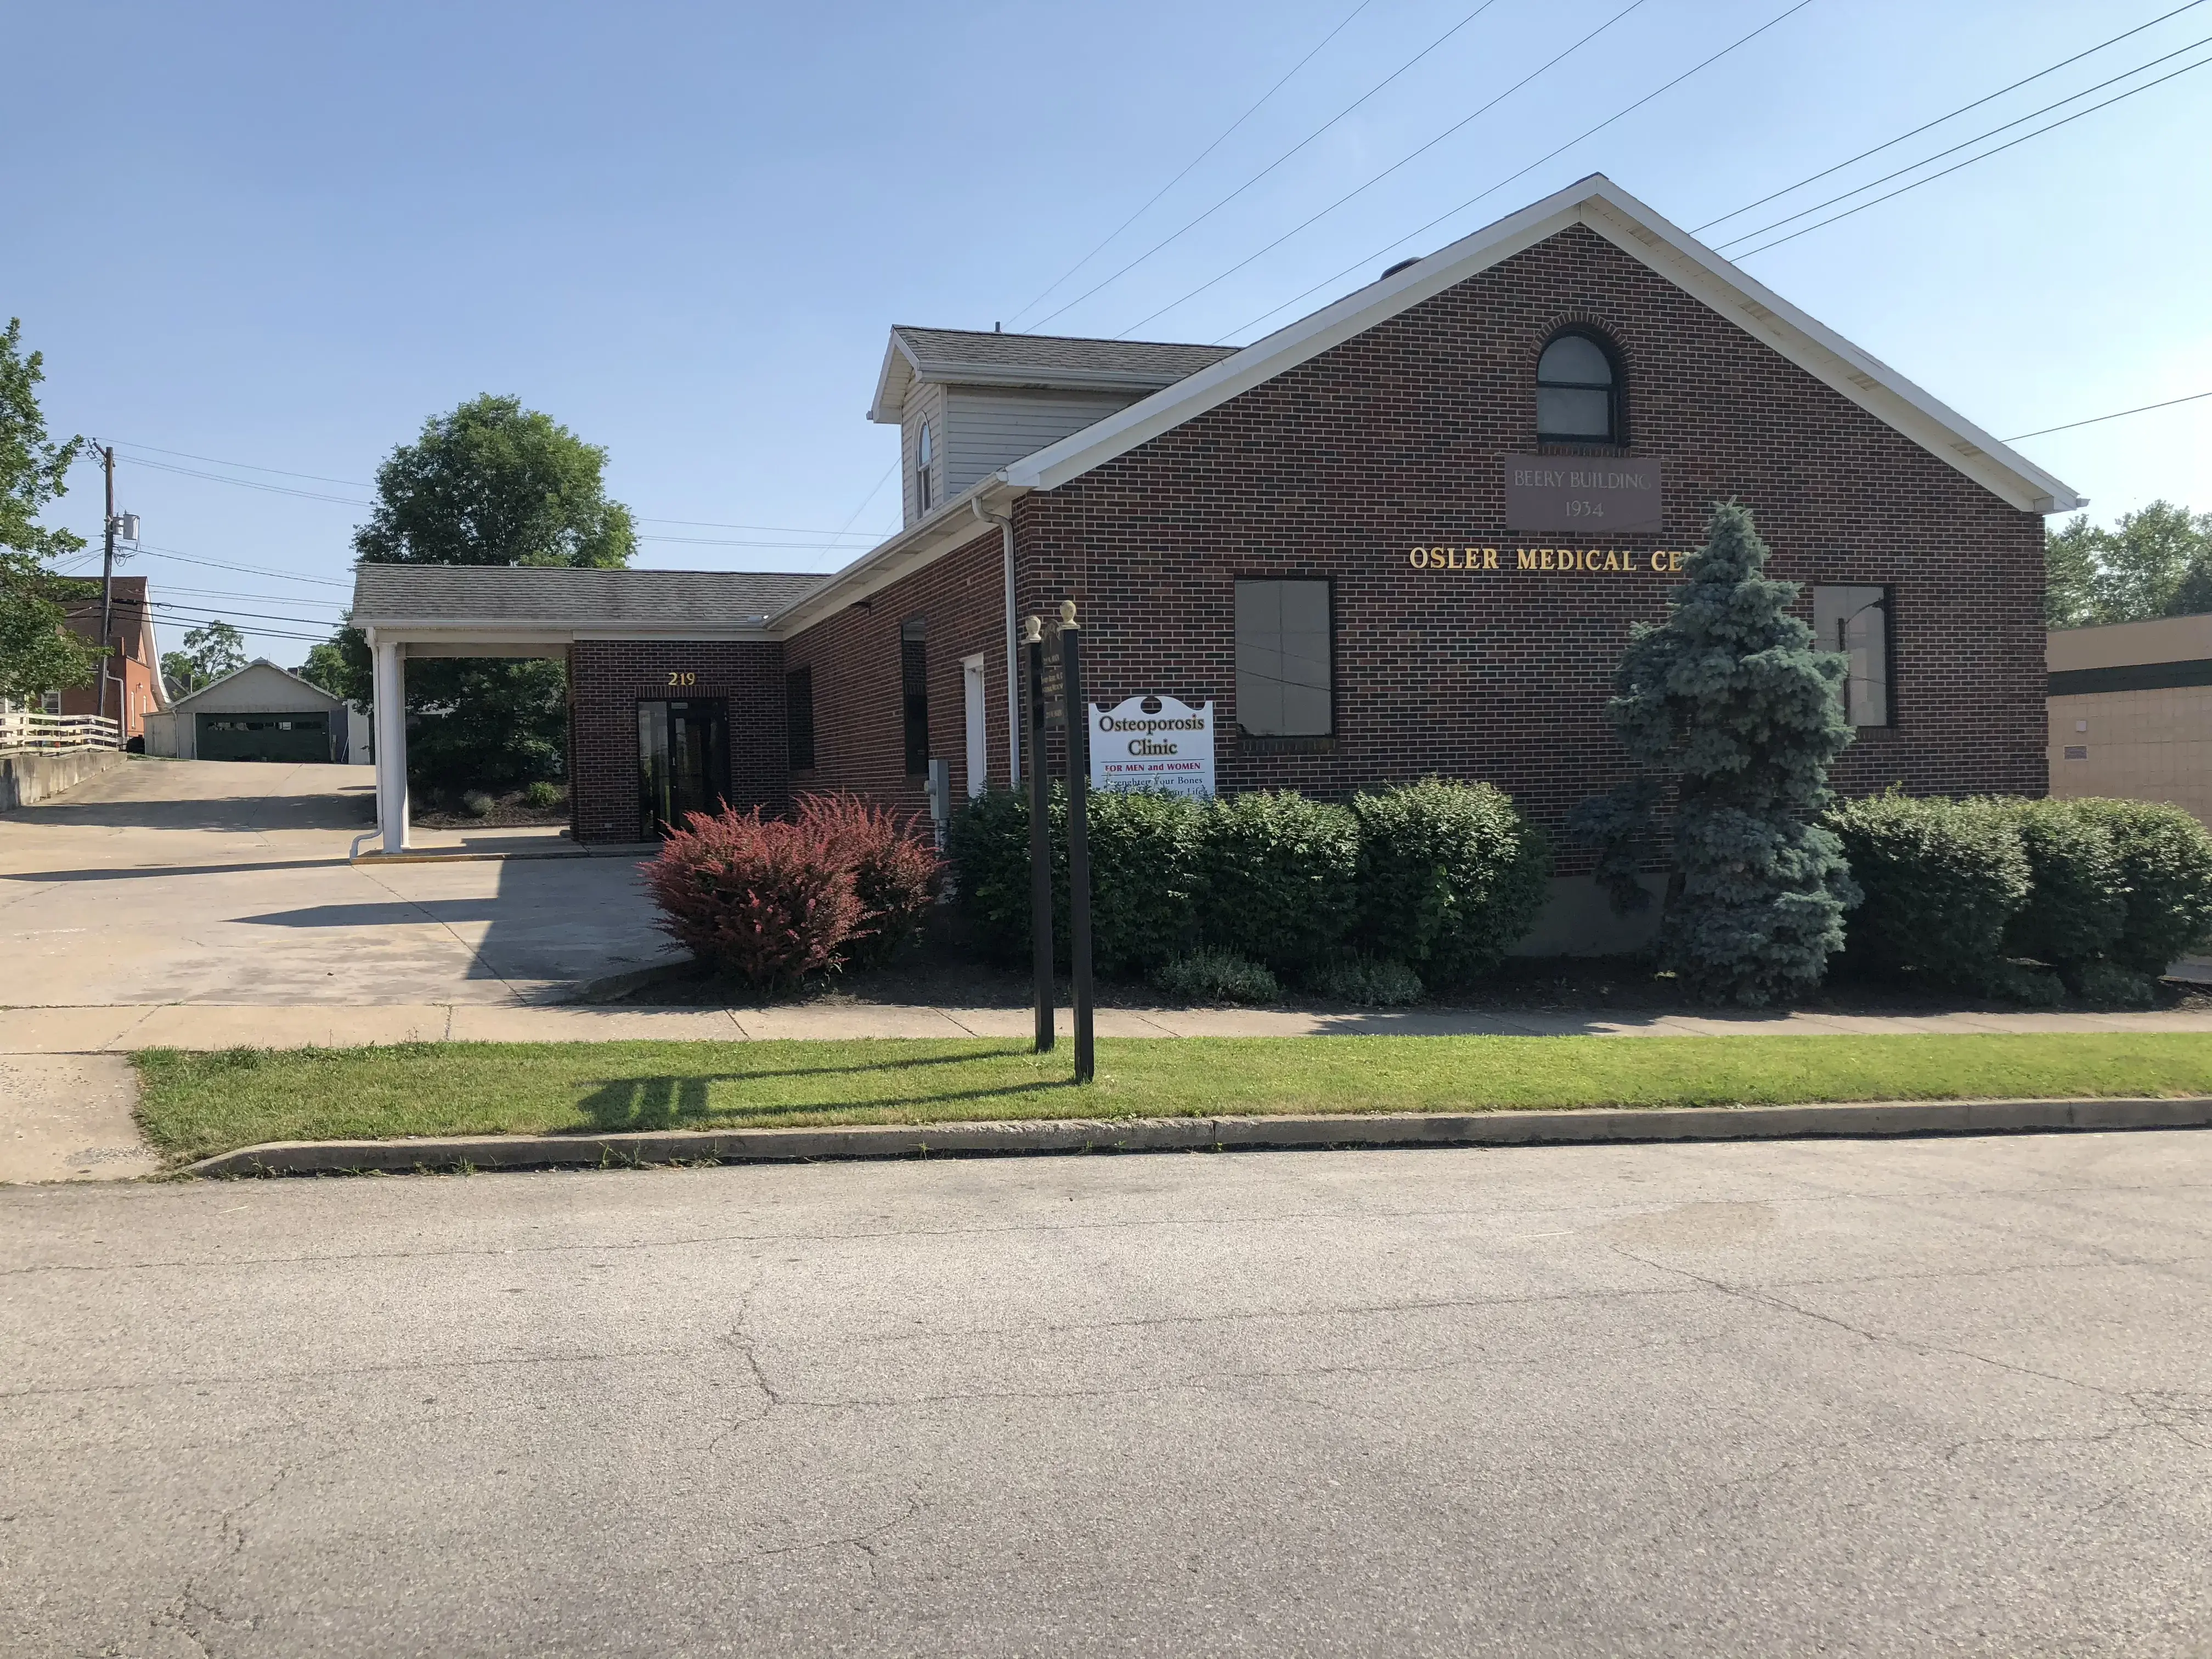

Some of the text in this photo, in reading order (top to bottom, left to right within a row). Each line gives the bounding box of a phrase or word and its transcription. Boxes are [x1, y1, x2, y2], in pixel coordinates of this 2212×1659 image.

[1514, 470, 1651, 490] BEERY BUILDING
[1565, 500, 1605, 517] 1934
[1409, 546, 1684, 572] OSLER MEDICAL CE
[668, 672, 695, 685] 219
[1098, 713, 1205, 736] Osteoporosis
[1127, 738, 1178, 757] Clinic
[1166, 762, 1201, 770] WOMEN
